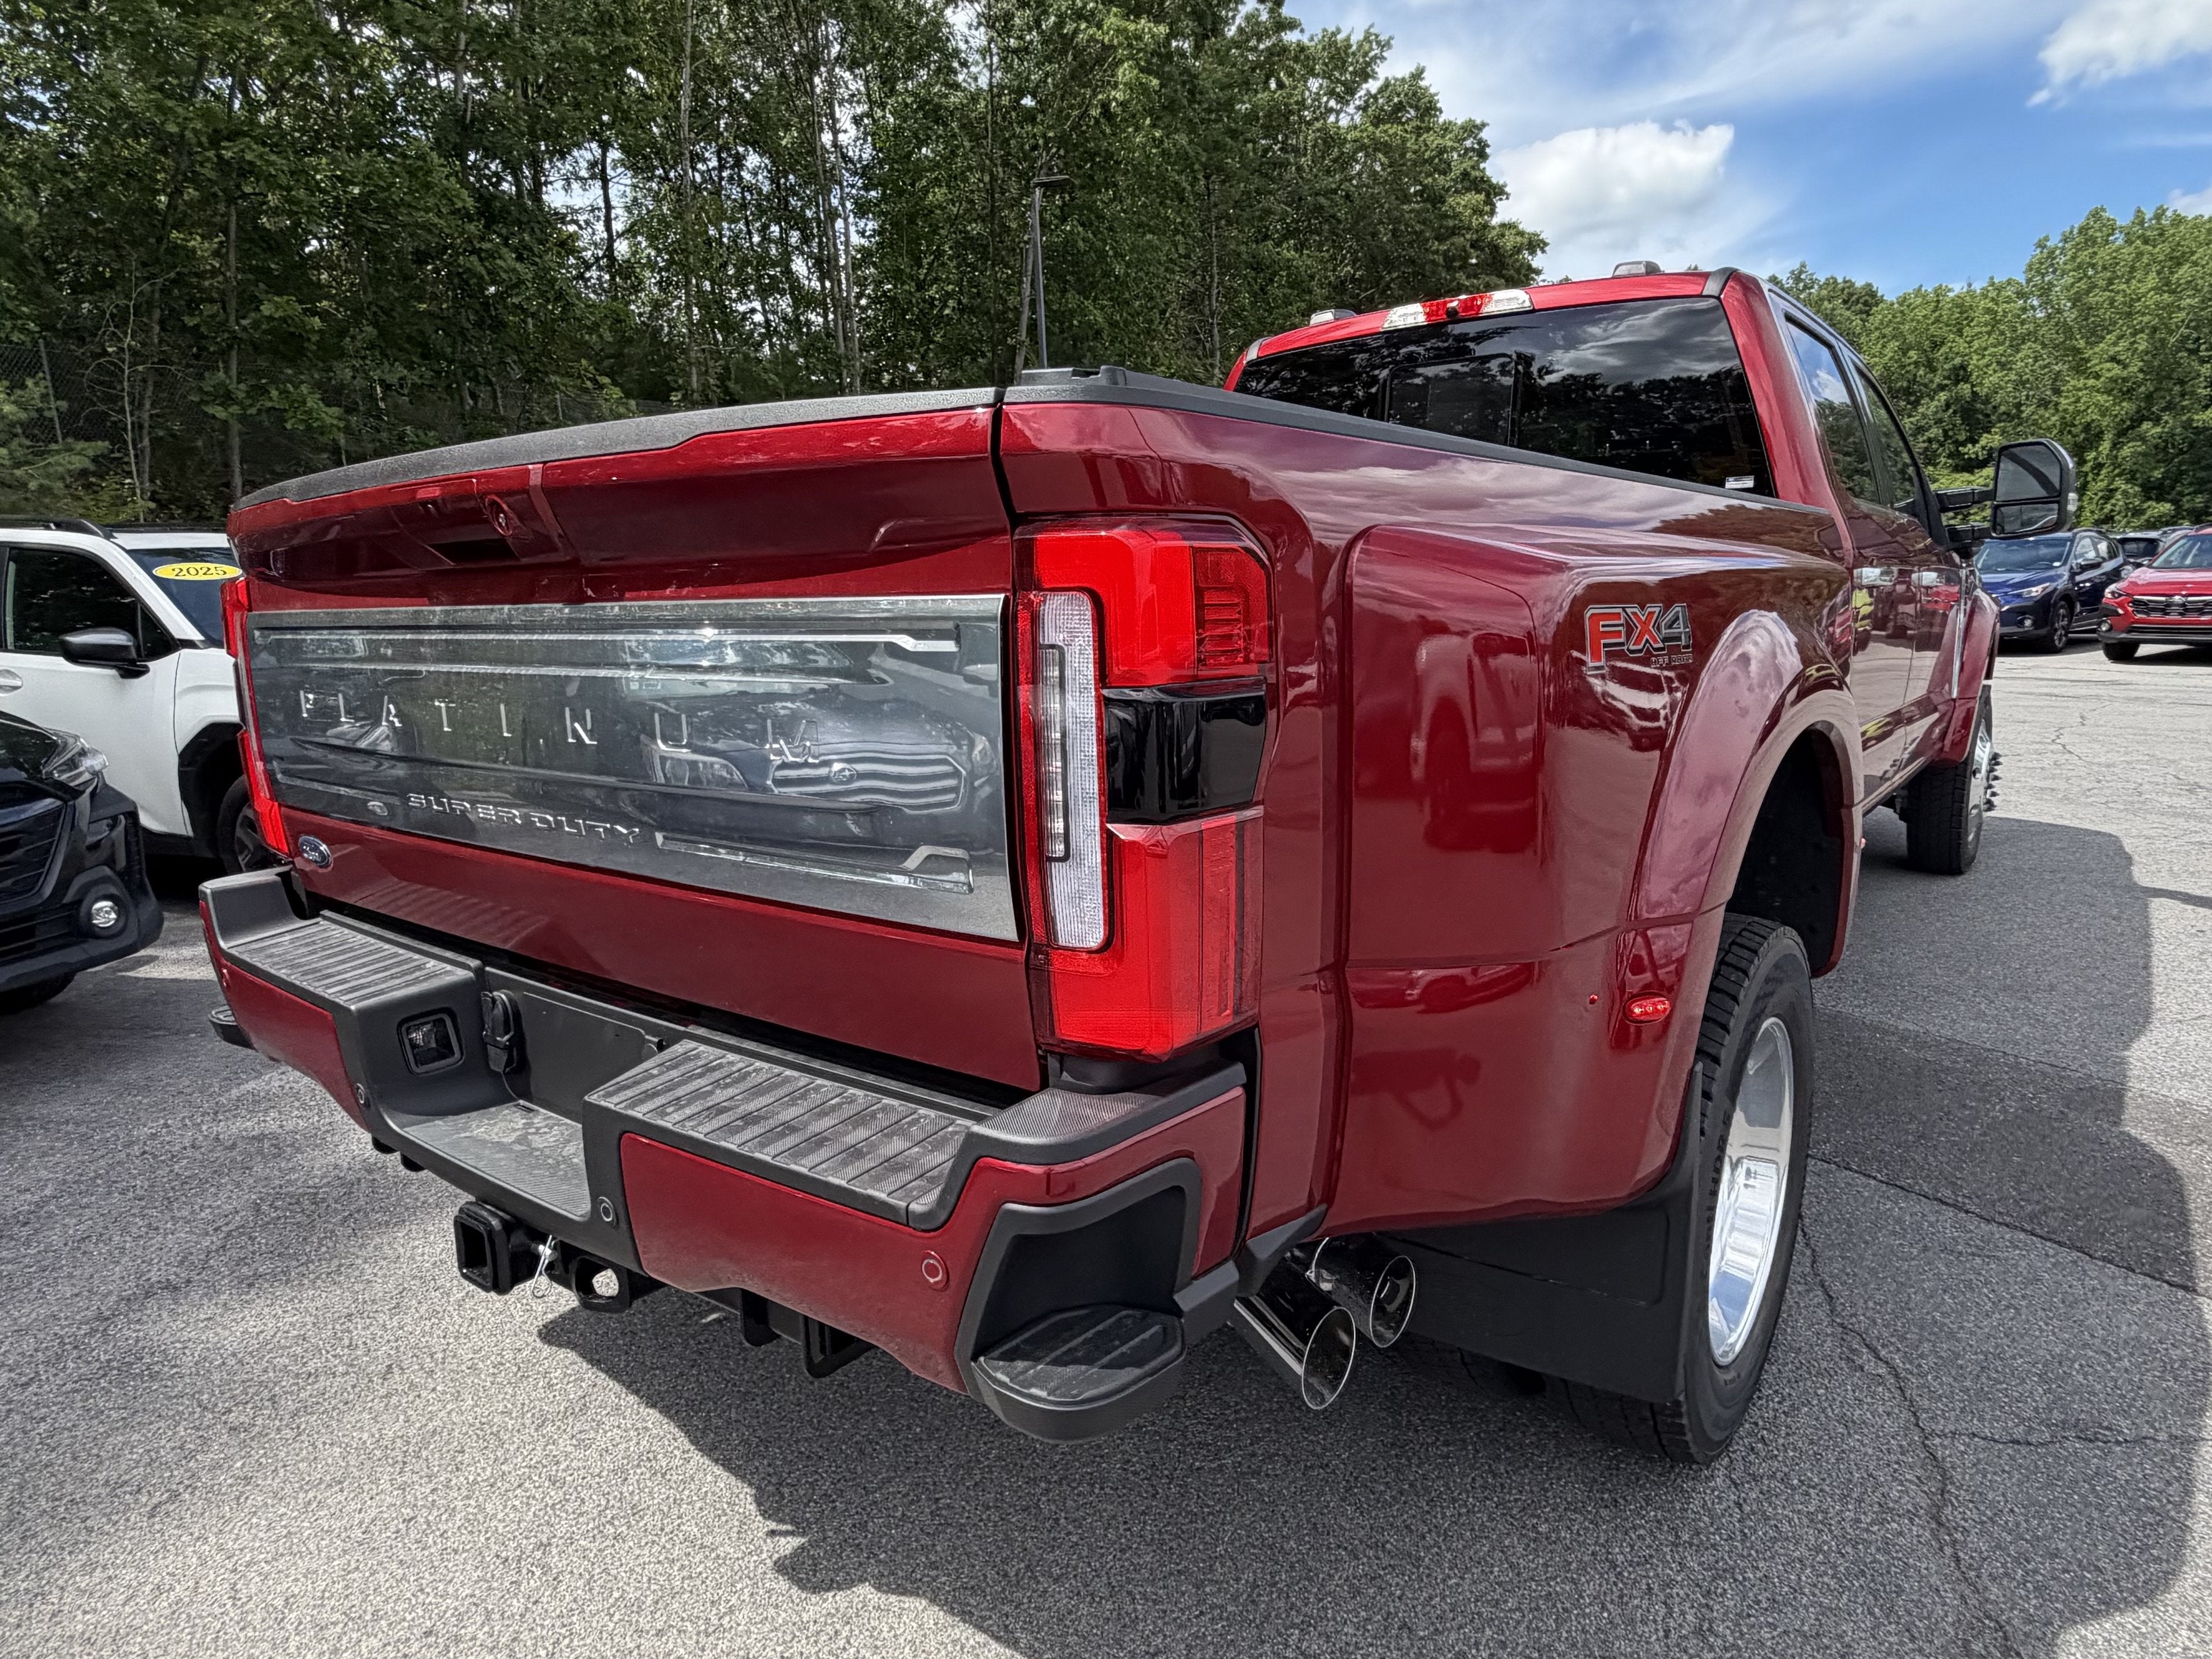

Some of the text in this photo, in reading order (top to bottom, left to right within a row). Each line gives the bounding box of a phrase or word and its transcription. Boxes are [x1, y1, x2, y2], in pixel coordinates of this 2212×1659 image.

[172, 566, 227, 577] 2025
[1584, 603, 1693, 675] FX4
[299, 685, 819, 763] PLATINUM
[407, 794, 639, 844] SUPER DUTY
